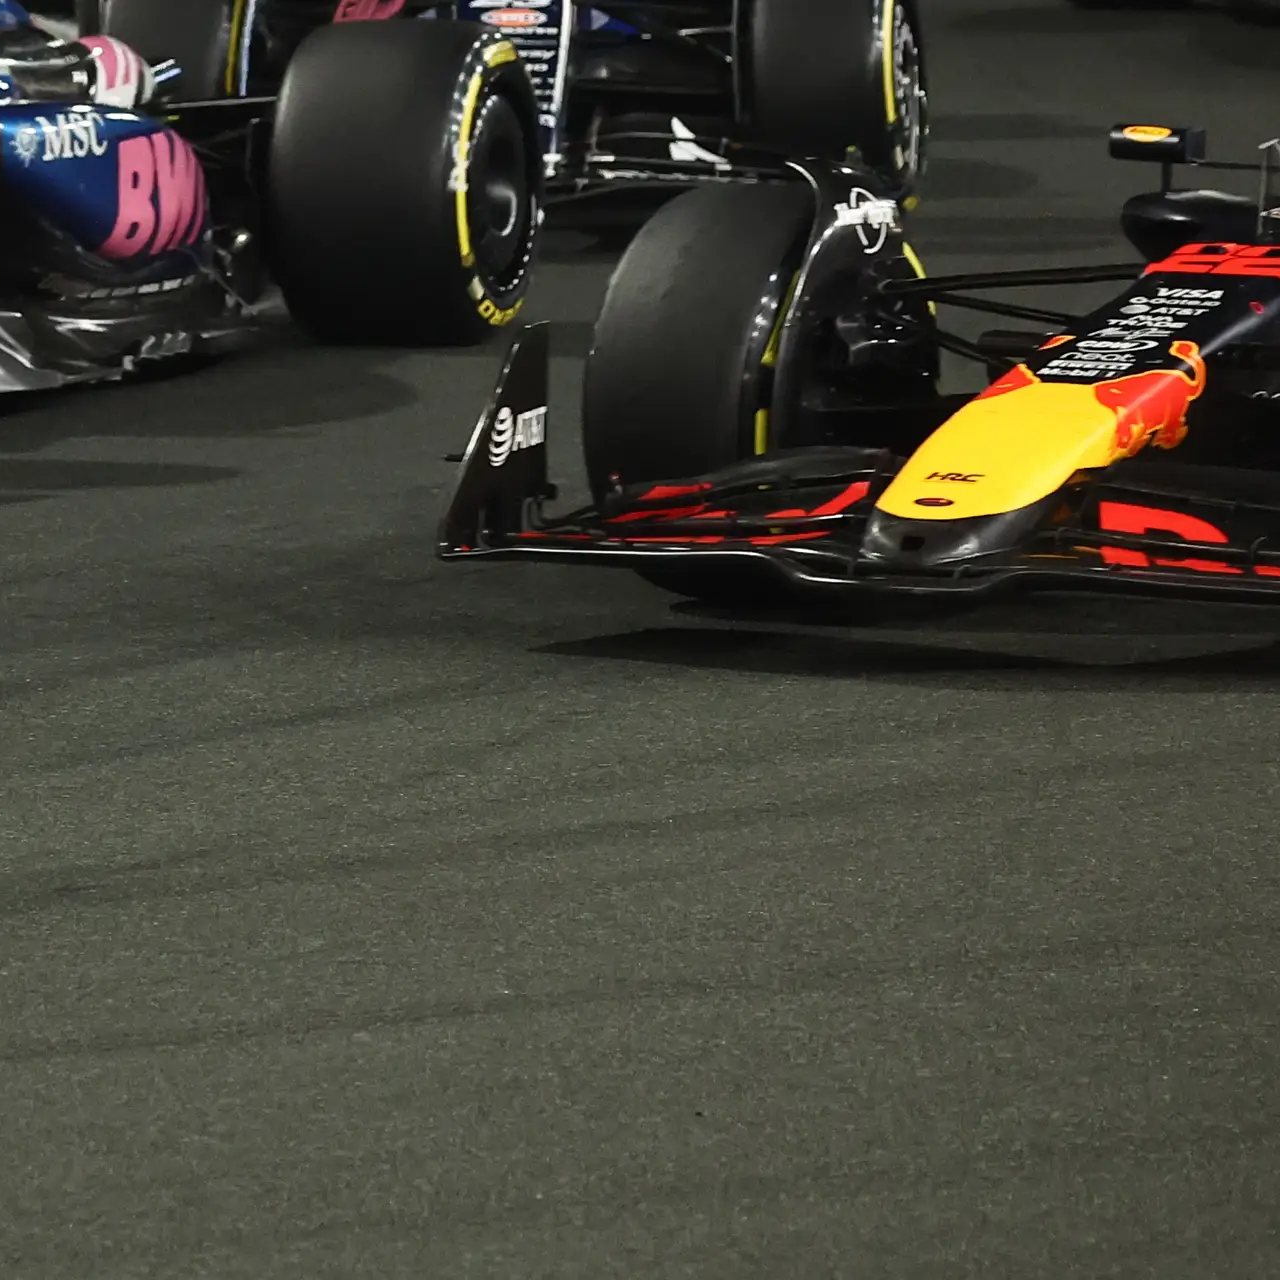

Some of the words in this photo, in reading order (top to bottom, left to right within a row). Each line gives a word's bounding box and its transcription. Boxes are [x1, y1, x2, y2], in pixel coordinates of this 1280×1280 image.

[34, 113, 109, 162] MSC
[1156, 286, 1225, 300] VISA
[1035, 367, 1101, 377] Mobil
